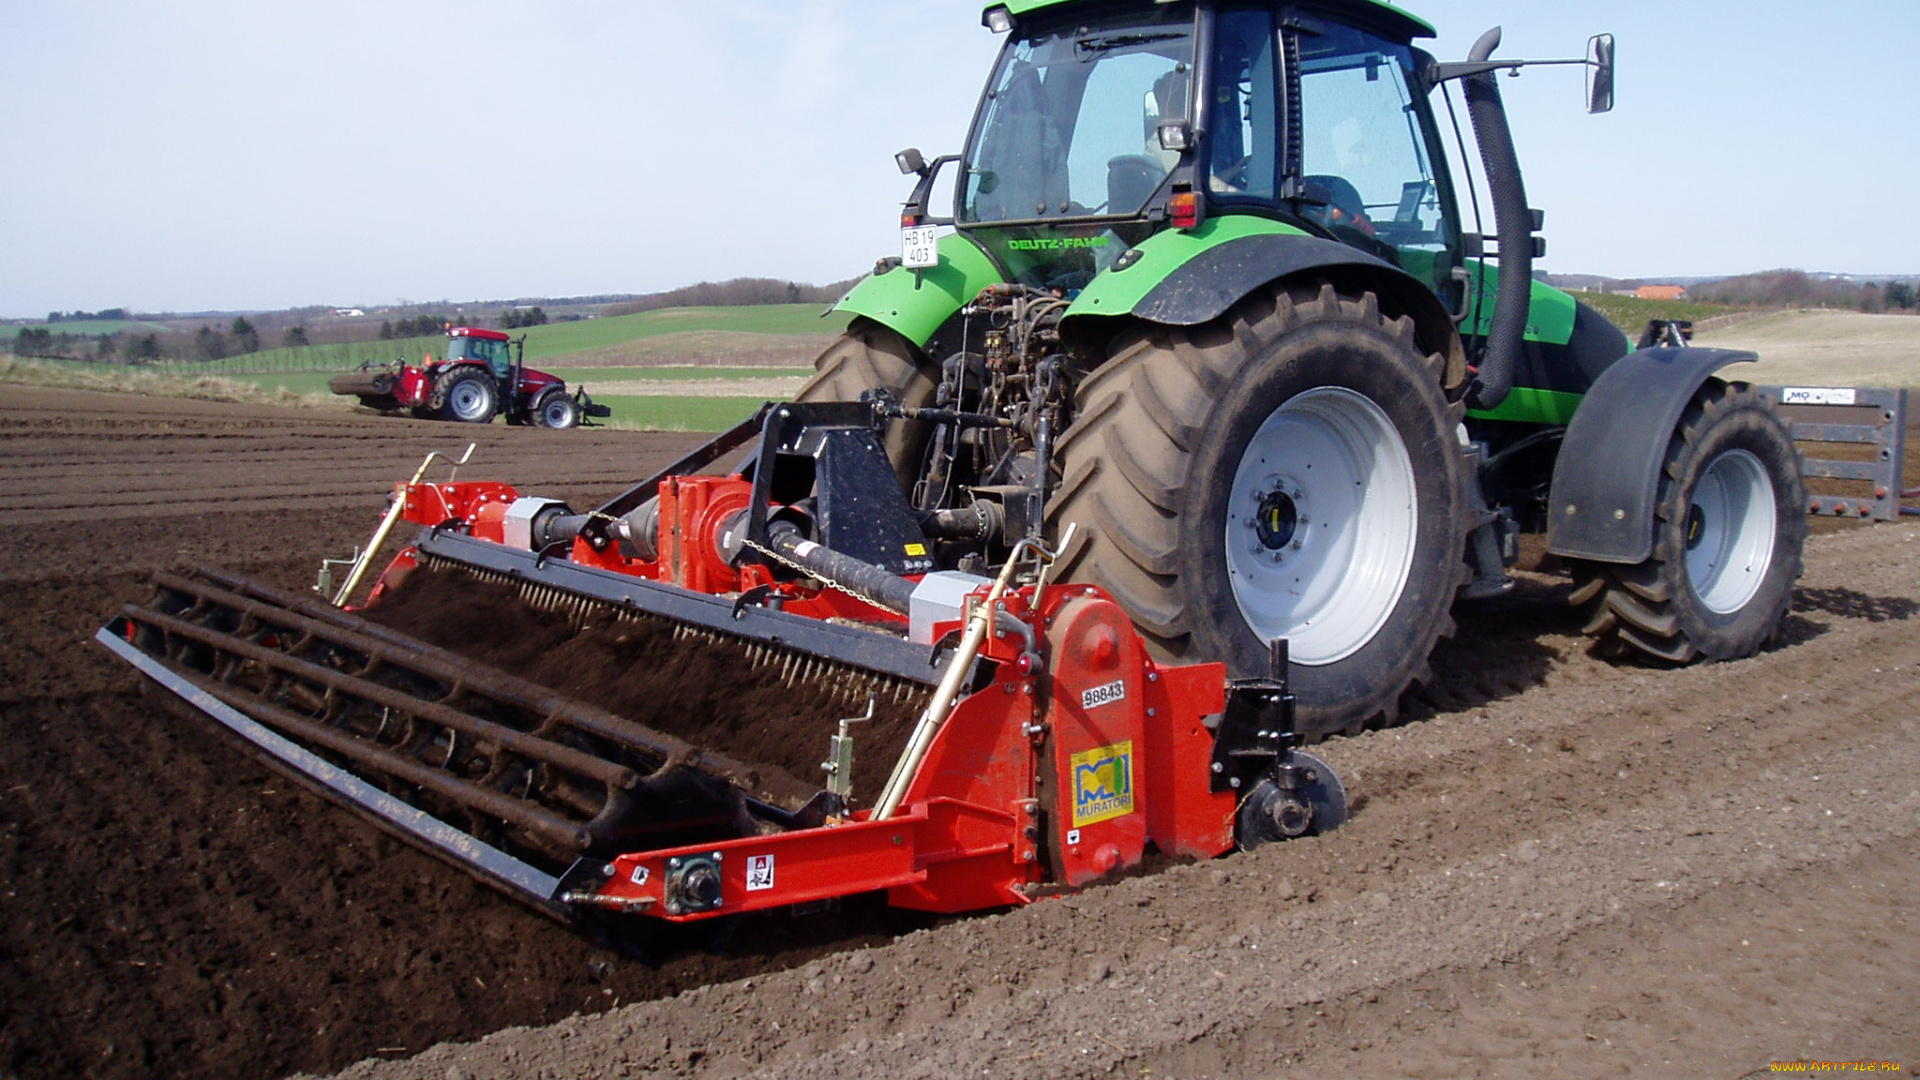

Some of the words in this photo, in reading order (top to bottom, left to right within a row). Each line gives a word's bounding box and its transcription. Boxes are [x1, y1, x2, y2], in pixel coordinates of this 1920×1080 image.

[904, 231, 919, 247] HB
[921, 229, 934, 246] 19
[909, 247, 929, 262] 403
[1084, 683, 1123, 707] 98843
[1077, 794, 1131, 818] MURATORI
